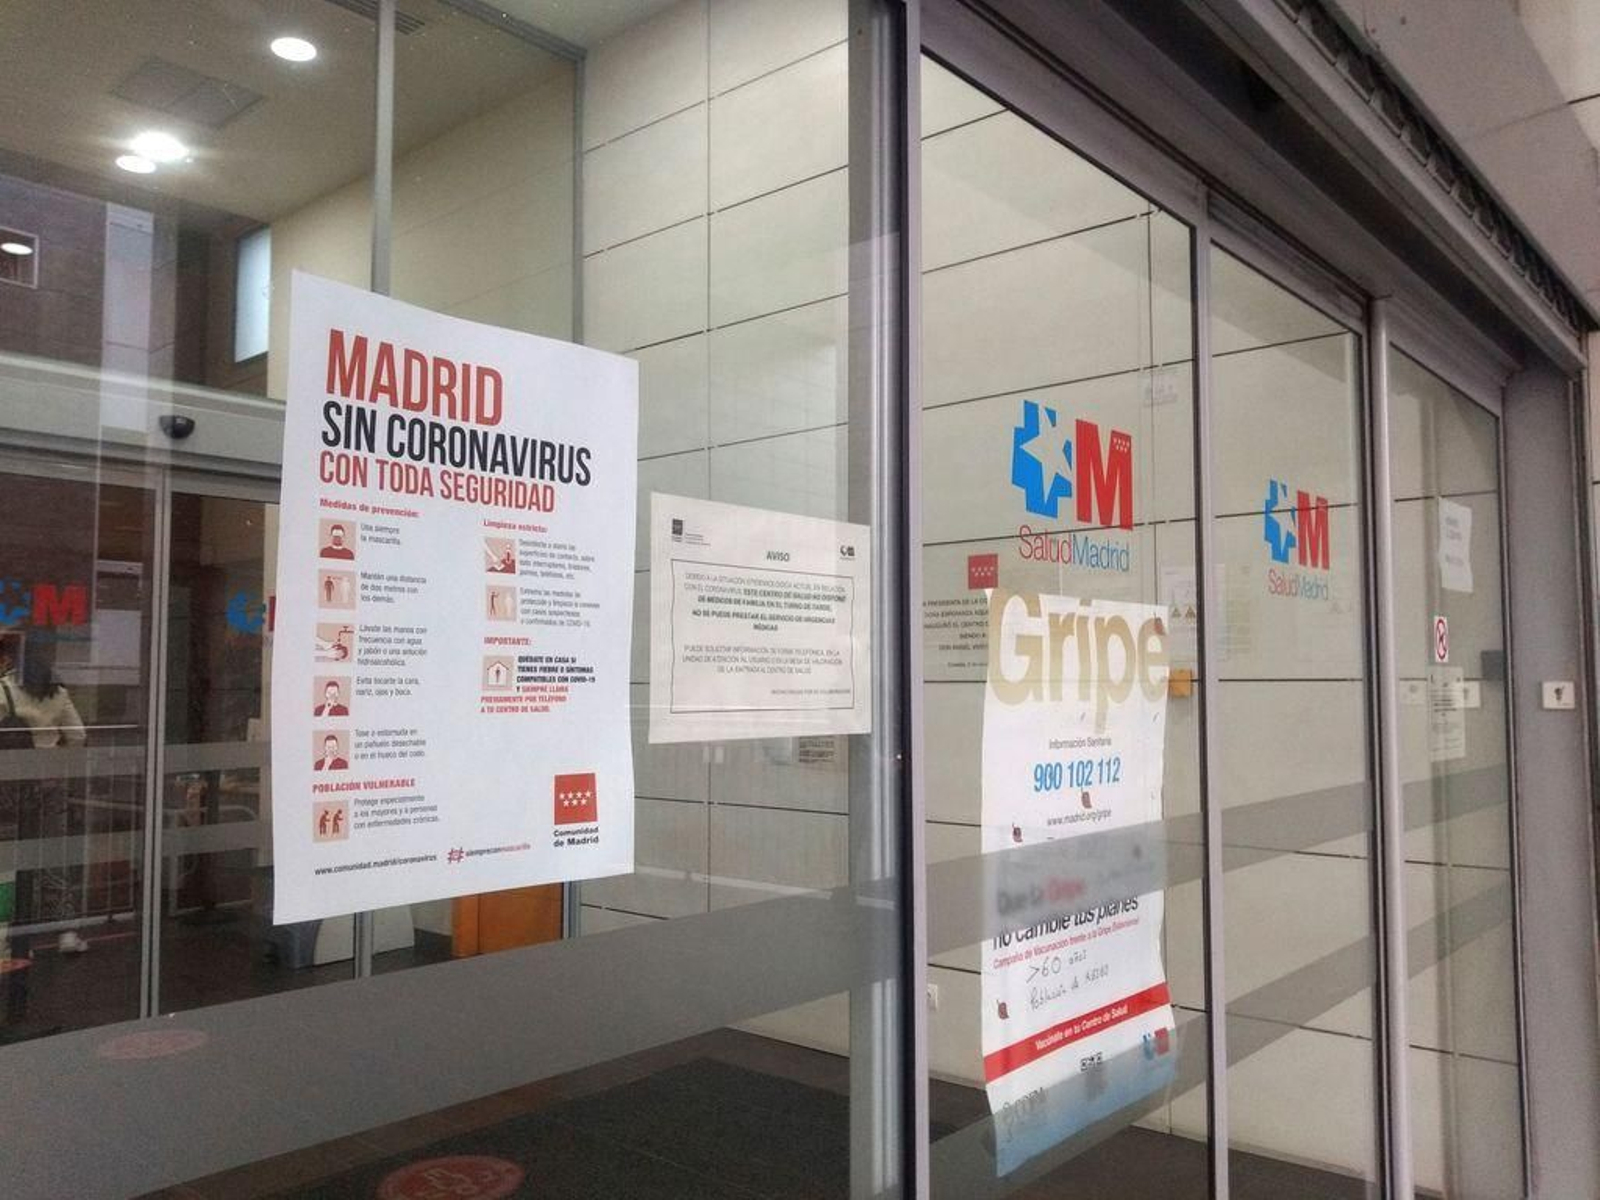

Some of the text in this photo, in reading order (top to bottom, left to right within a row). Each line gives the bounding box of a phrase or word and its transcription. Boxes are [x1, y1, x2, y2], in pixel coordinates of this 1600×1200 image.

[326, 328, 503, 427] MADRID
[322, 400, 592, 486] SIN CORONAVIRUS
[319, 450, 556, 513] CON TODA SEGURIDAD
[319, 499, 357, 510] Medidas
[359, 502, 370, 512] de
[766, 550, 790, 562] AVISO
[1018, 525, 1131, 573] SaludMadrid
[484, 636, 532, 646] IMPORTANTE:
[988, 587, 1170, 735] Gripe
[1049, 736, 1112, 750] Información Sanitaria
[1034, 756, 1121, 792] 900 102 112
[312, 778, 416, 793] POBLACIÓN VULNERABLE
[553, 826, 599, 838] Comunidad
[553, 834, 600, 848] de Madrid
[314, 854, 438, 876] www.comunidad.madrid/coronavirus
[992, 931, 1012, 950] no
[1074, 910, 1094, 928] tus
